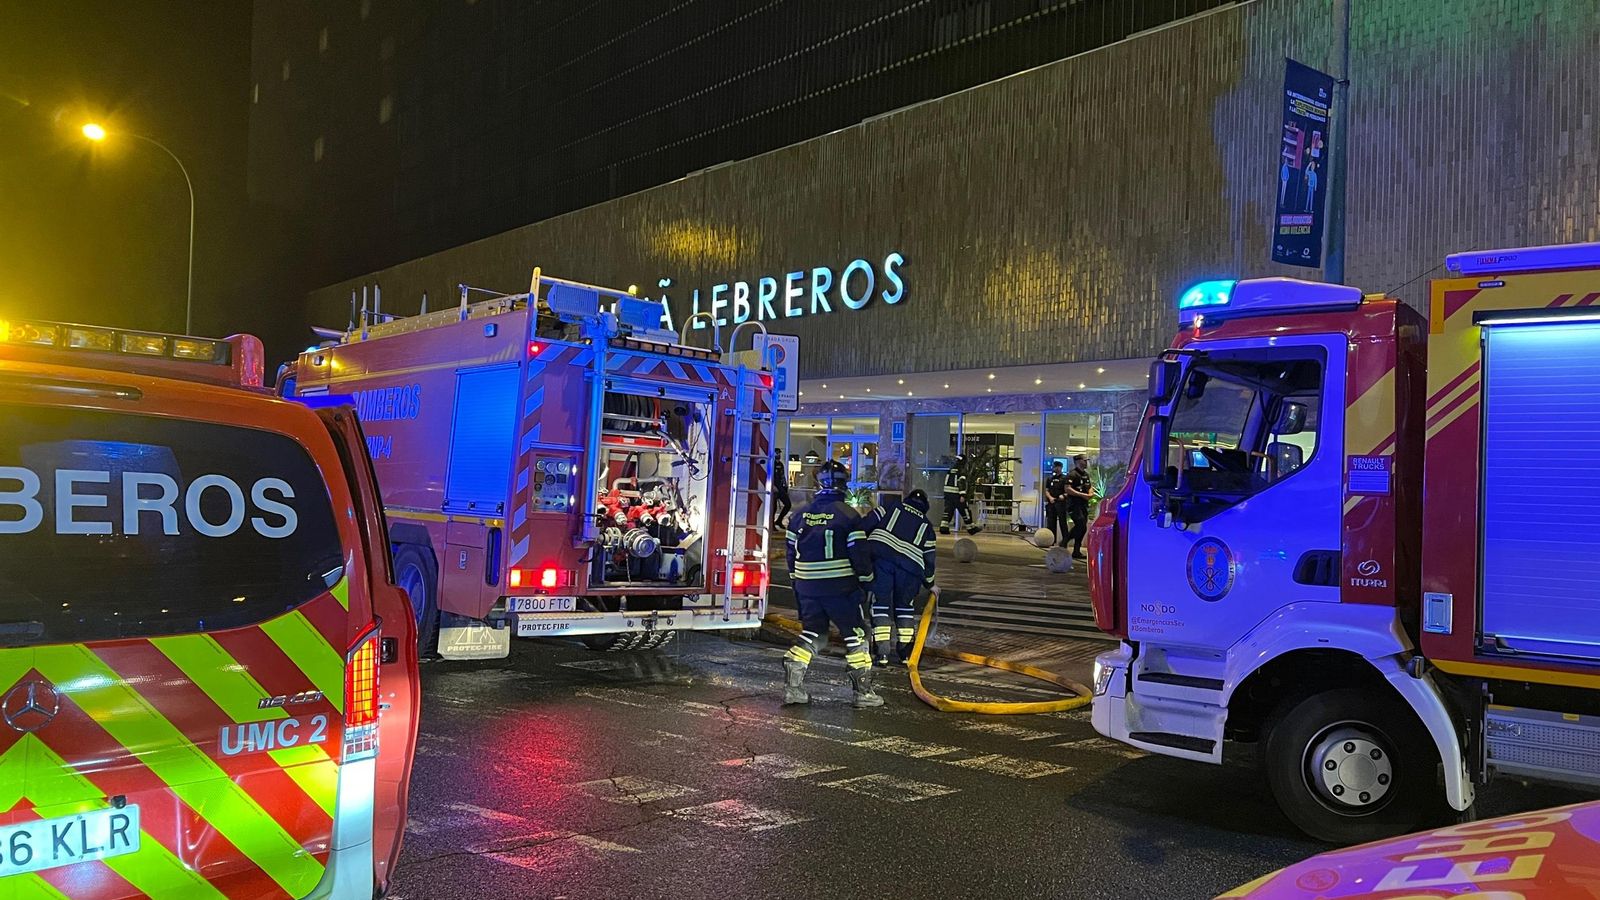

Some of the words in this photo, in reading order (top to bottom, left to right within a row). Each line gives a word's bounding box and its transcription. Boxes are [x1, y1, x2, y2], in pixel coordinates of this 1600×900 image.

[693, 252, 906, 331] LEBREROS
[1353, 457, 1385, 465] RENAULT
[0, 466, 298, 539] BEROS
[516, 598, 546, 610] 7800
[549, 598, 570, 610] FTC
[521, 623, 570, 631] PROTEC-FIRE
[447, 644, 503, 652] PROTEC-FIRE
[221, 718, 300, 756] UMC
[308, 714, 328, 744] 2
[0, 829, 33, 867] 6
[51, 813, 131, 861] KLR
